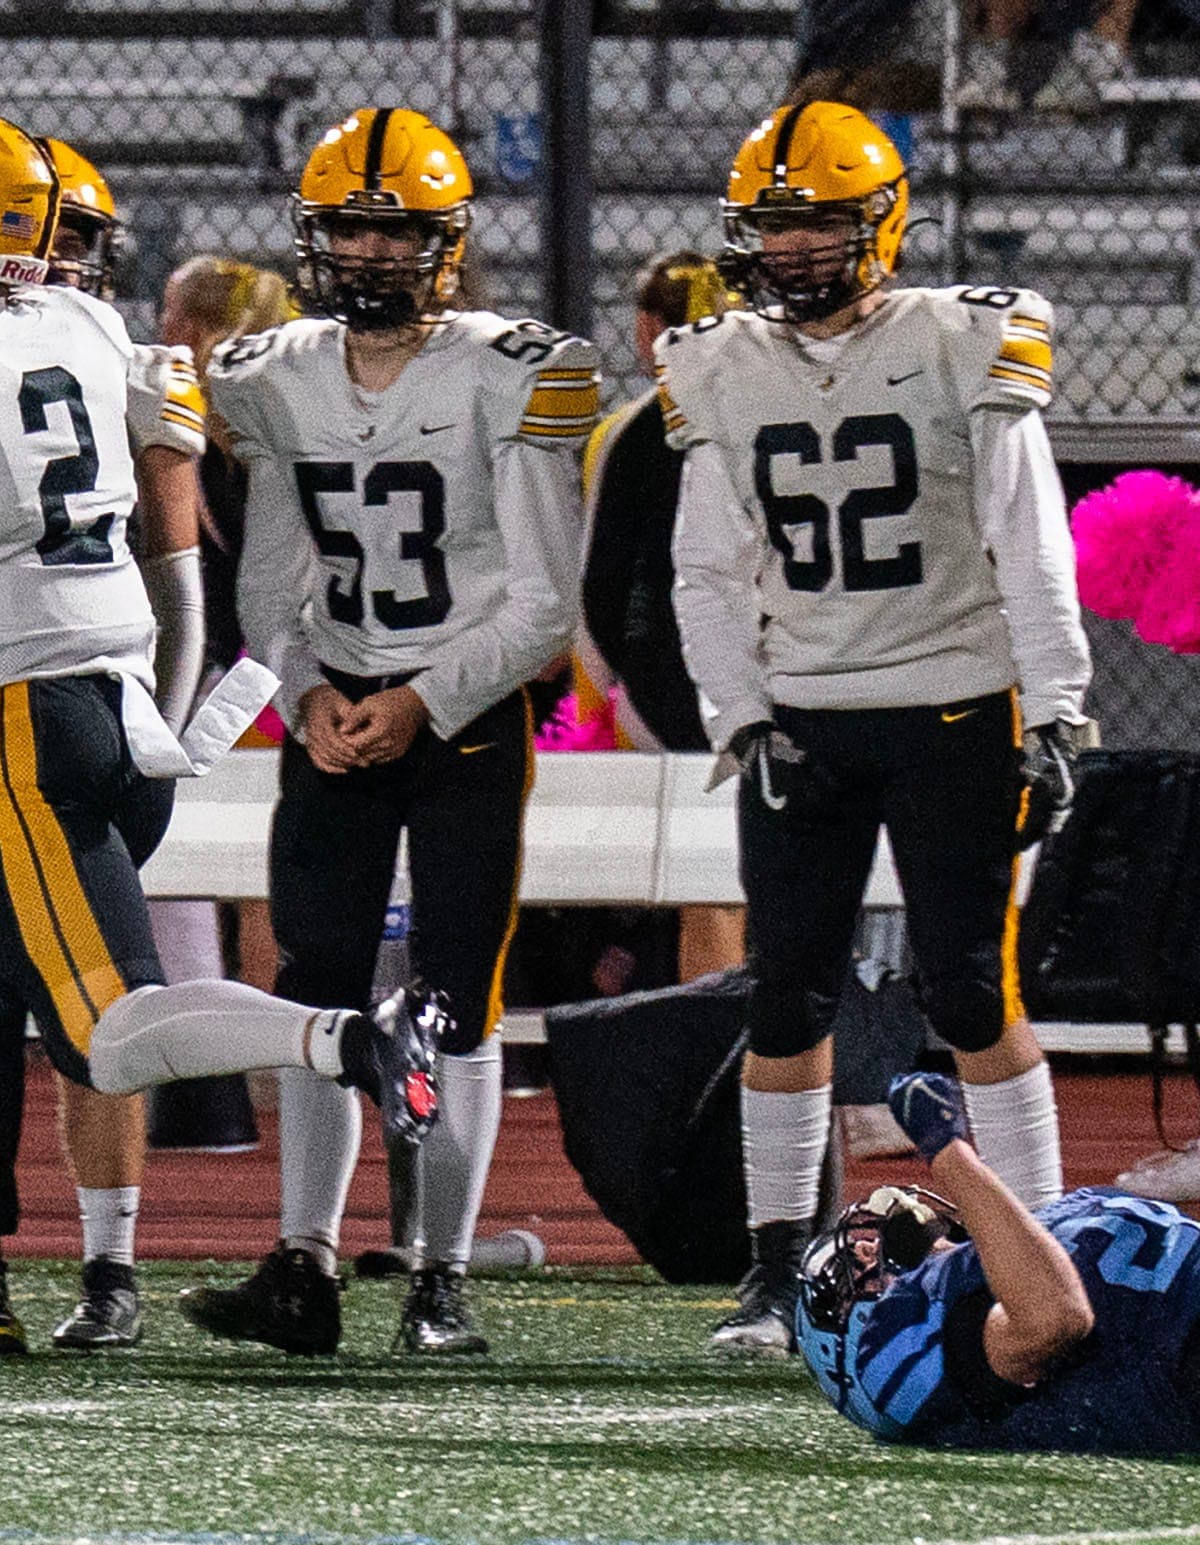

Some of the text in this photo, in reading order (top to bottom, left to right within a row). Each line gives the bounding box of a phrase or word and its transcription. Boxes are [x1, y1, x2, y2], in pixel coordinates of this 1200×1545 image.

[18, 366, 114, 566] 2
[295, 461, 452, 629] 53
[756, 414, 924, 593] 62
